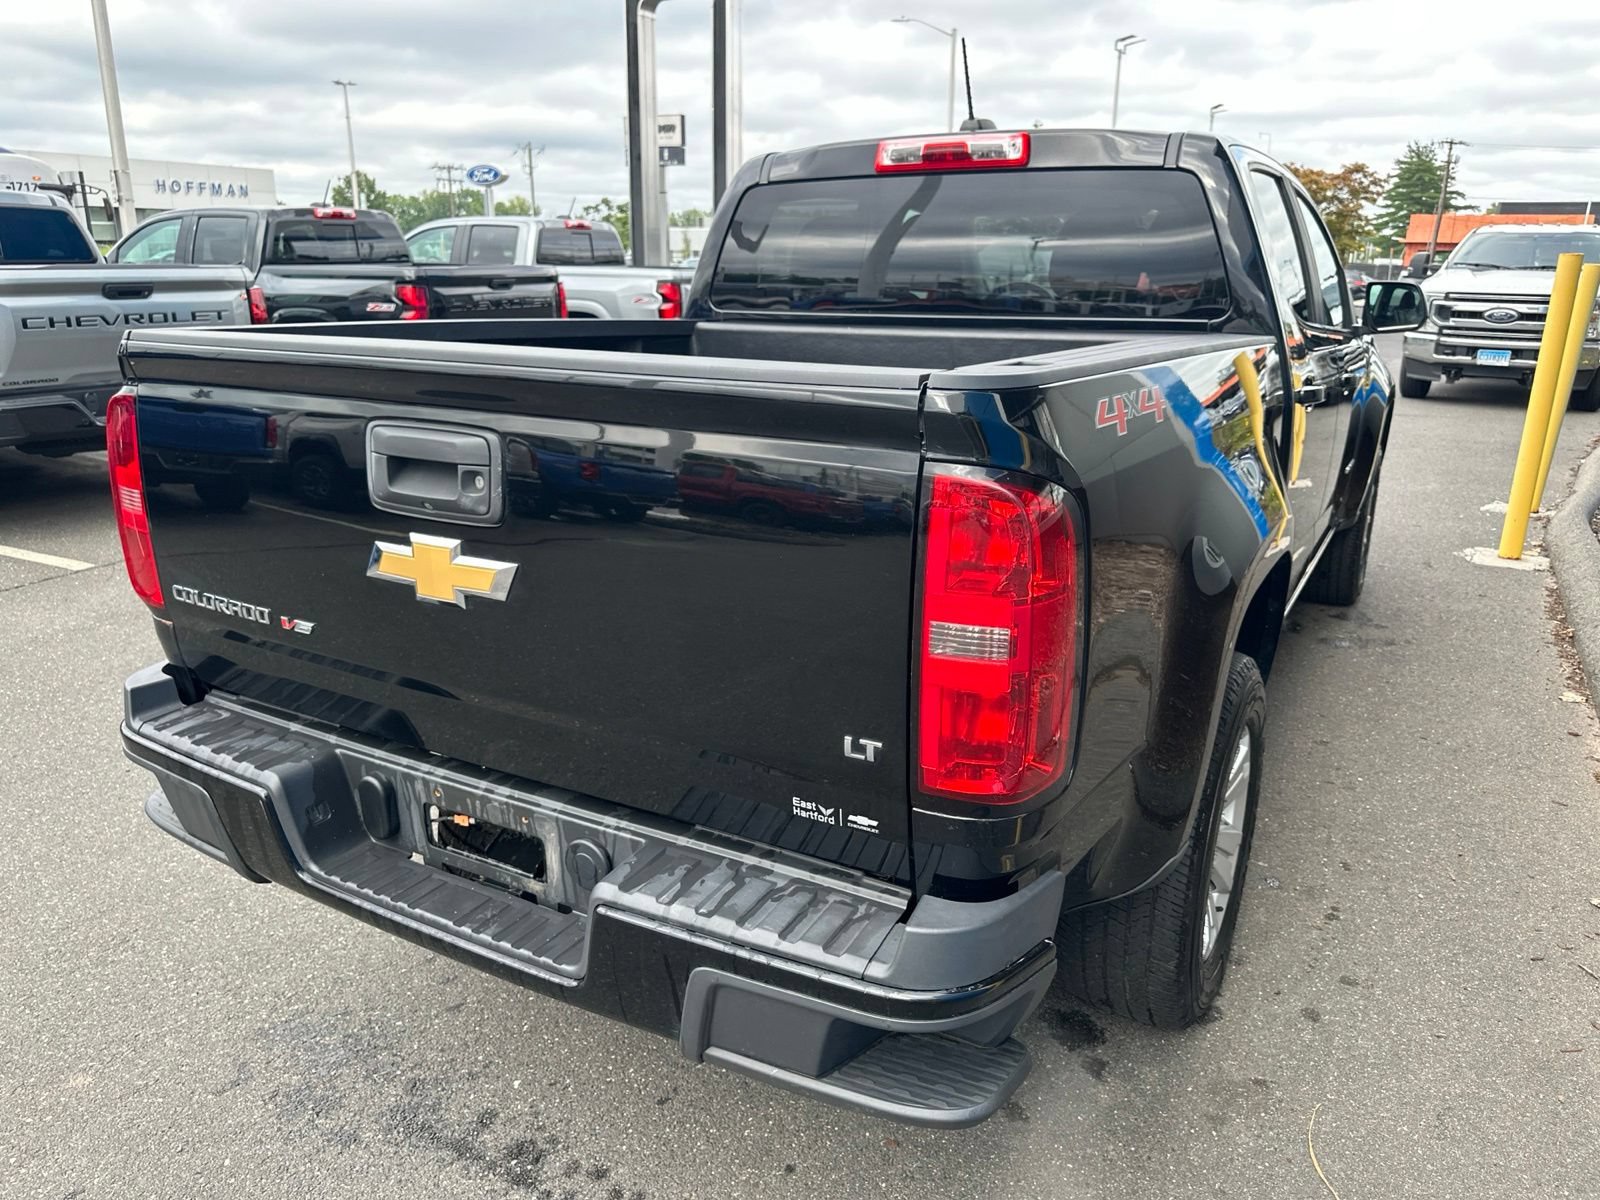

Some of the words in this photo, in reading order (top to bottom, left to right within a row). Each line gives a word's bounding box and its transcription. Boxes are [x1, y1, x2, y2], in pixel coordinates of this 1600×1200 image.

[472, 168, 496, 182] Ford
[155, 179, 249, 198] HOFFMAN
[21, 310, 230, 330] CHEVROLET
[172, 584, 271, 625] COLORADO
[844, 735, 882, 762] LT
[792, 796, 816, 811] East
[793, 806, 835, 825] Hartford
